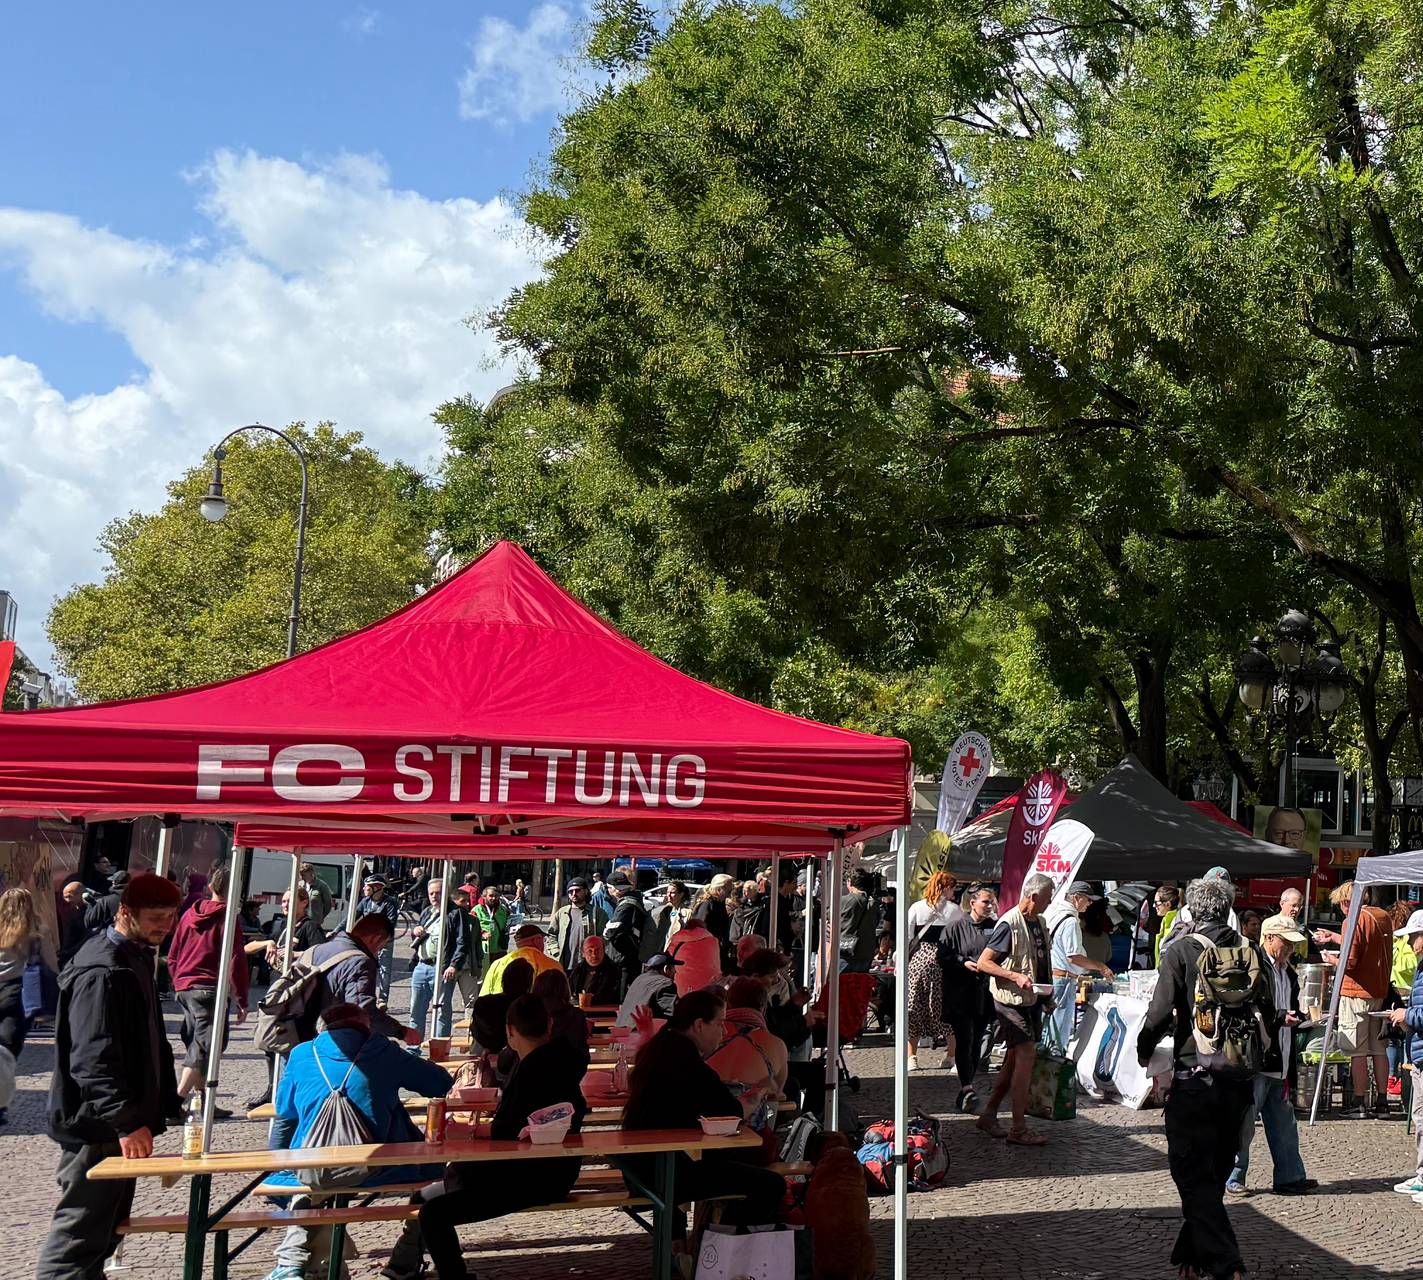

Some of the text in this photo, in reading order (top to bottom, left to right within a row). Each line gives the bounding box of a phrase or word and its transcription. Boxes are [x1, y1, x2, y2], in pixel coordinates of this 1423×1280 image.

[955, 736, 988, 758] DEUTSCHES
[196, 744, 707, 808] FC STIFTUNG
[1036, 860, 1073, 873] SKM
